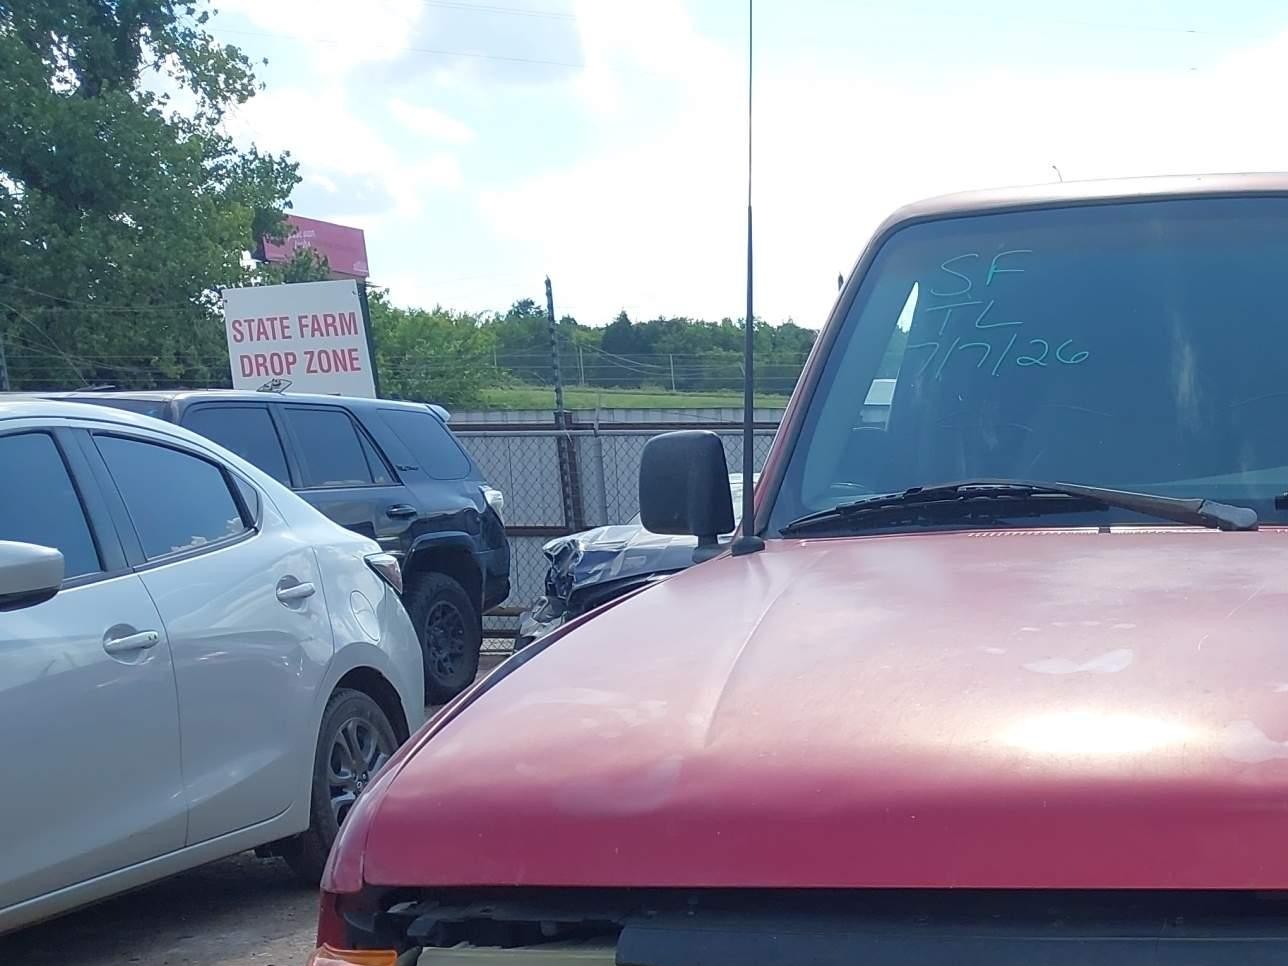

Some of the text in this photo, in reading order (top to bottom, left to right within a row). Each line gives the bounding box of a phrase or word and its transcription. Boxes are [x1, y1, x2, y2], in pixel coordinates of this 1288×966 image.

[930, 250, 1033, 296] SF
[231, 311, 359, 343] STATE FARM
[240, 348, 361, 378] DROP ZONE
[907, 333, 1089, 380] 7/7/26
